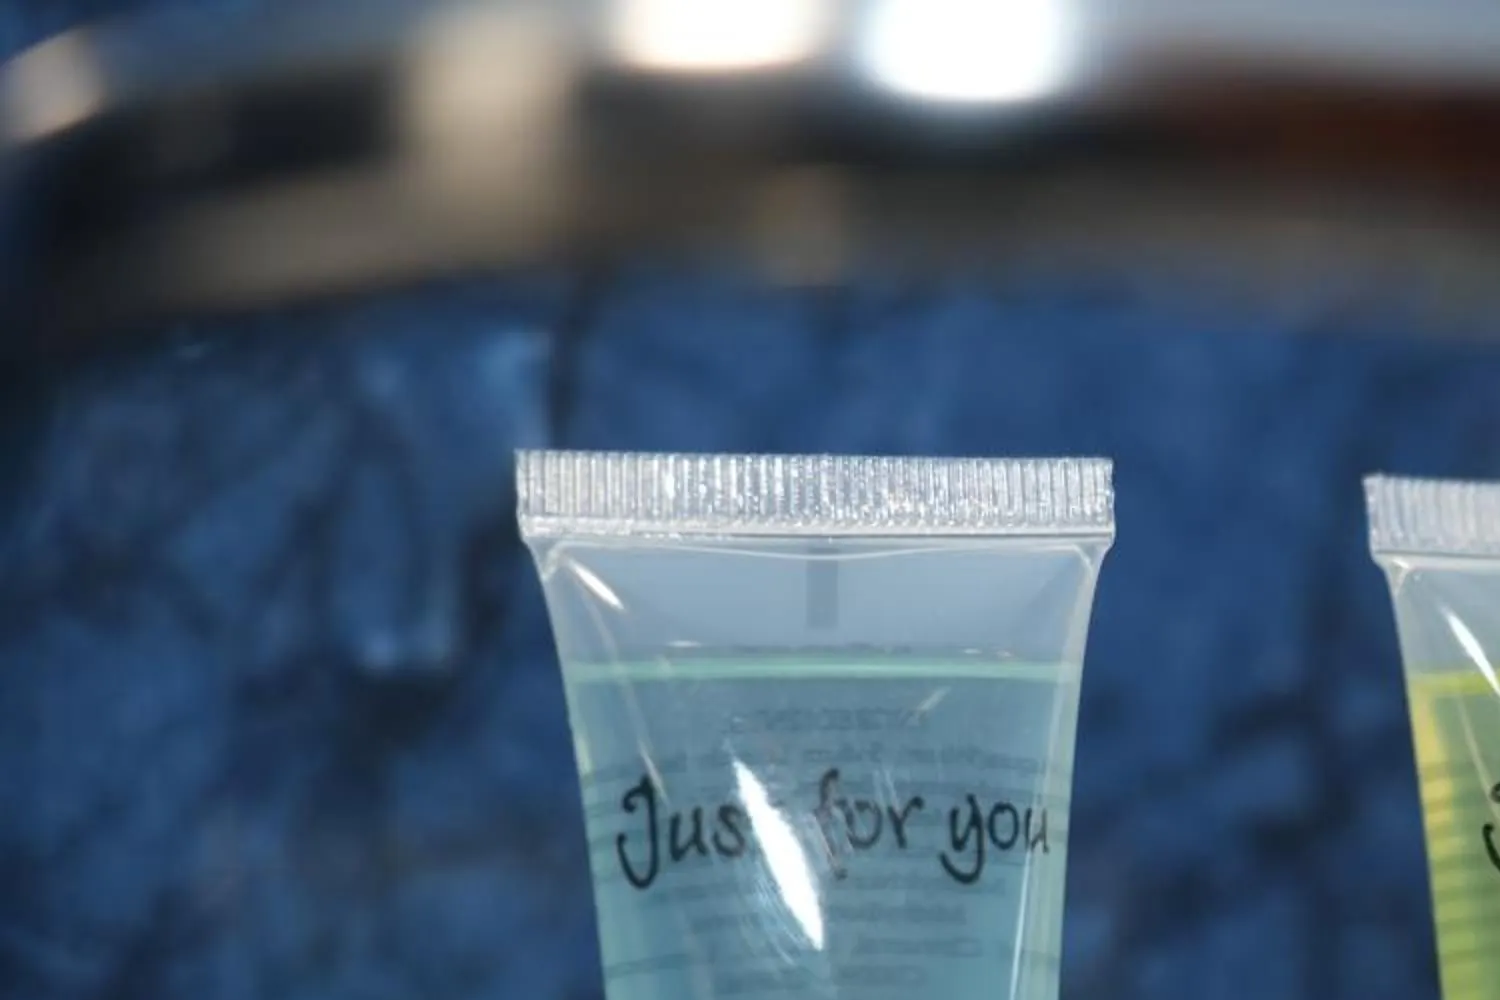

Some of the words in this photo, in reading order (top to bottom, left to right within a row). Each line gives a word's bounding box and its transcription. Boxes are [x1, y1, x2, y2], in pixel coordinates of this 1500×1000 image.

[617, 774, 760, 889] Jus
[815, 769, 923, 880] for
[940, 795, 1050, 884] you
